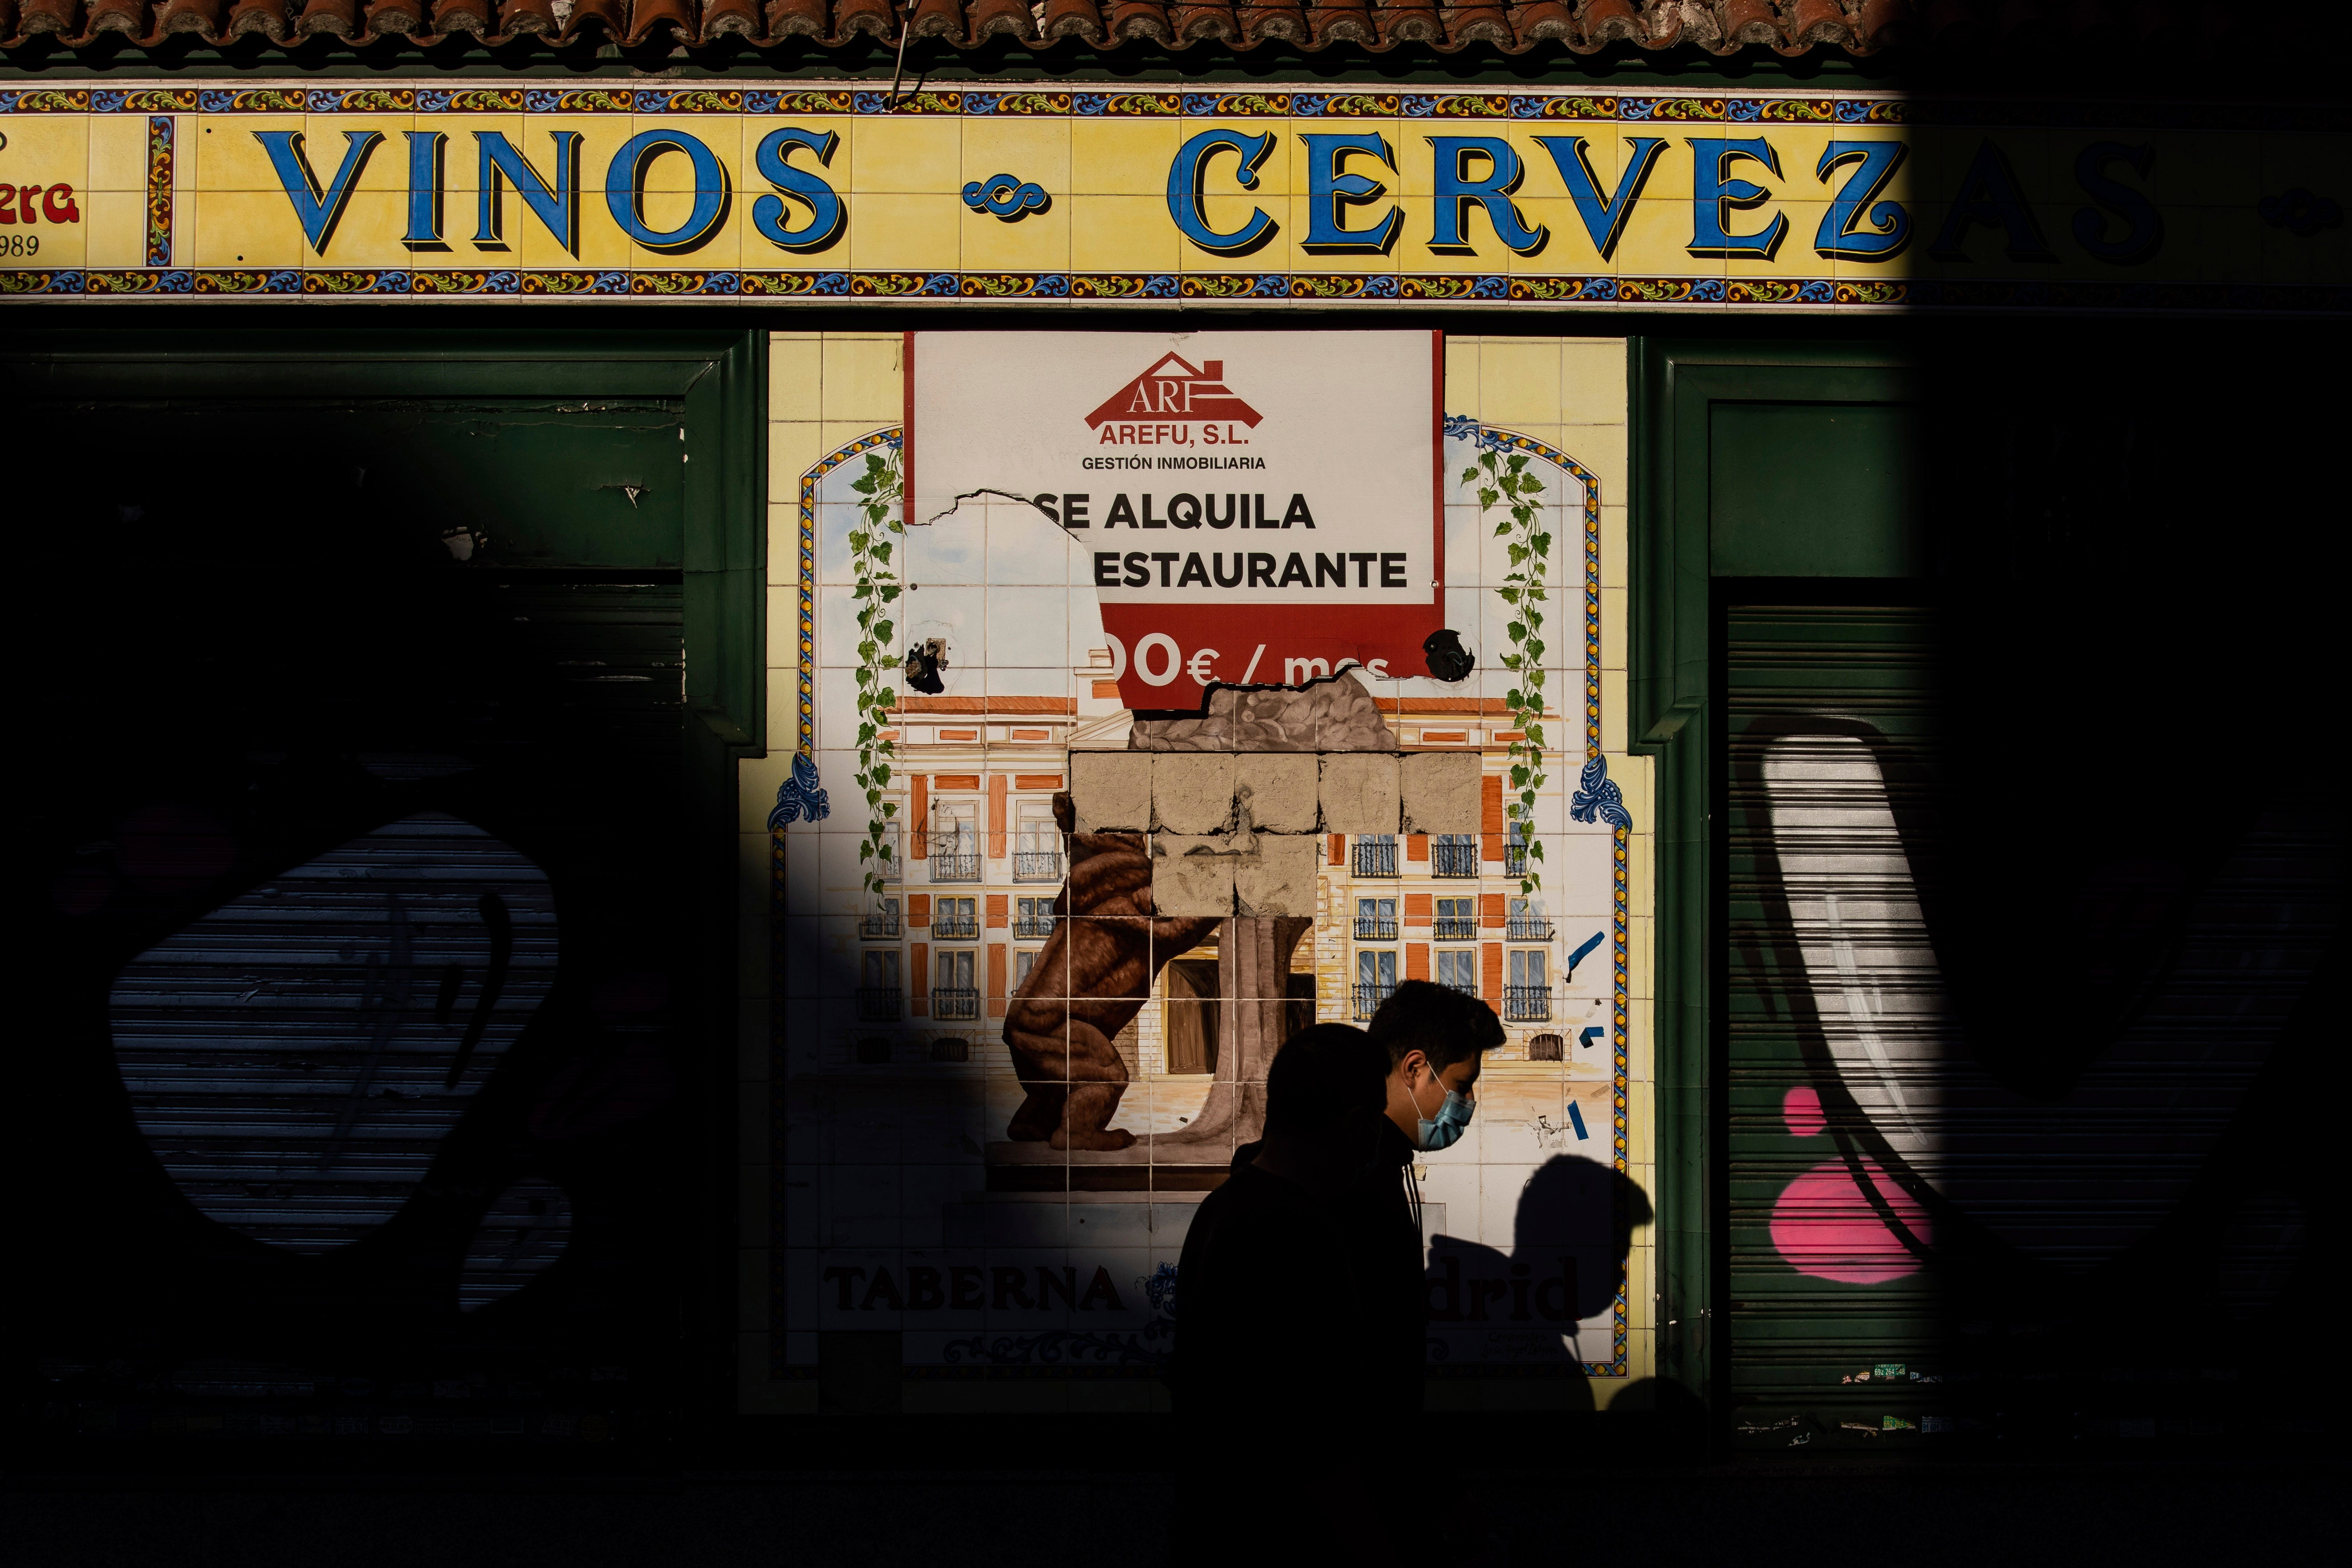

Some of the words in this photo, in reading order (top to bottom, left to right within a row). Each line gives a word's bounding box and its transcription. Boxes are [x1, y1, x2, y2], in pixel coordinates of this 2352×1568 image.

[250, 127, 848, 261] VINOS
[1167, 129, 2164, 265] CERVEZAS
[1100, 424, 1195, 448] AREFU,
[1203, 424, 1249, 445] S.L.
[1082, 454, 1152, 470] GESTIÓN
[1158, 457, 1266, 470] INMOBILIARIA
[1032, 493, 1090, 529] SE
[1104, 493, 1316, 530] ALQUILA
[823, 1264, 1127, 1313] TABERNA
